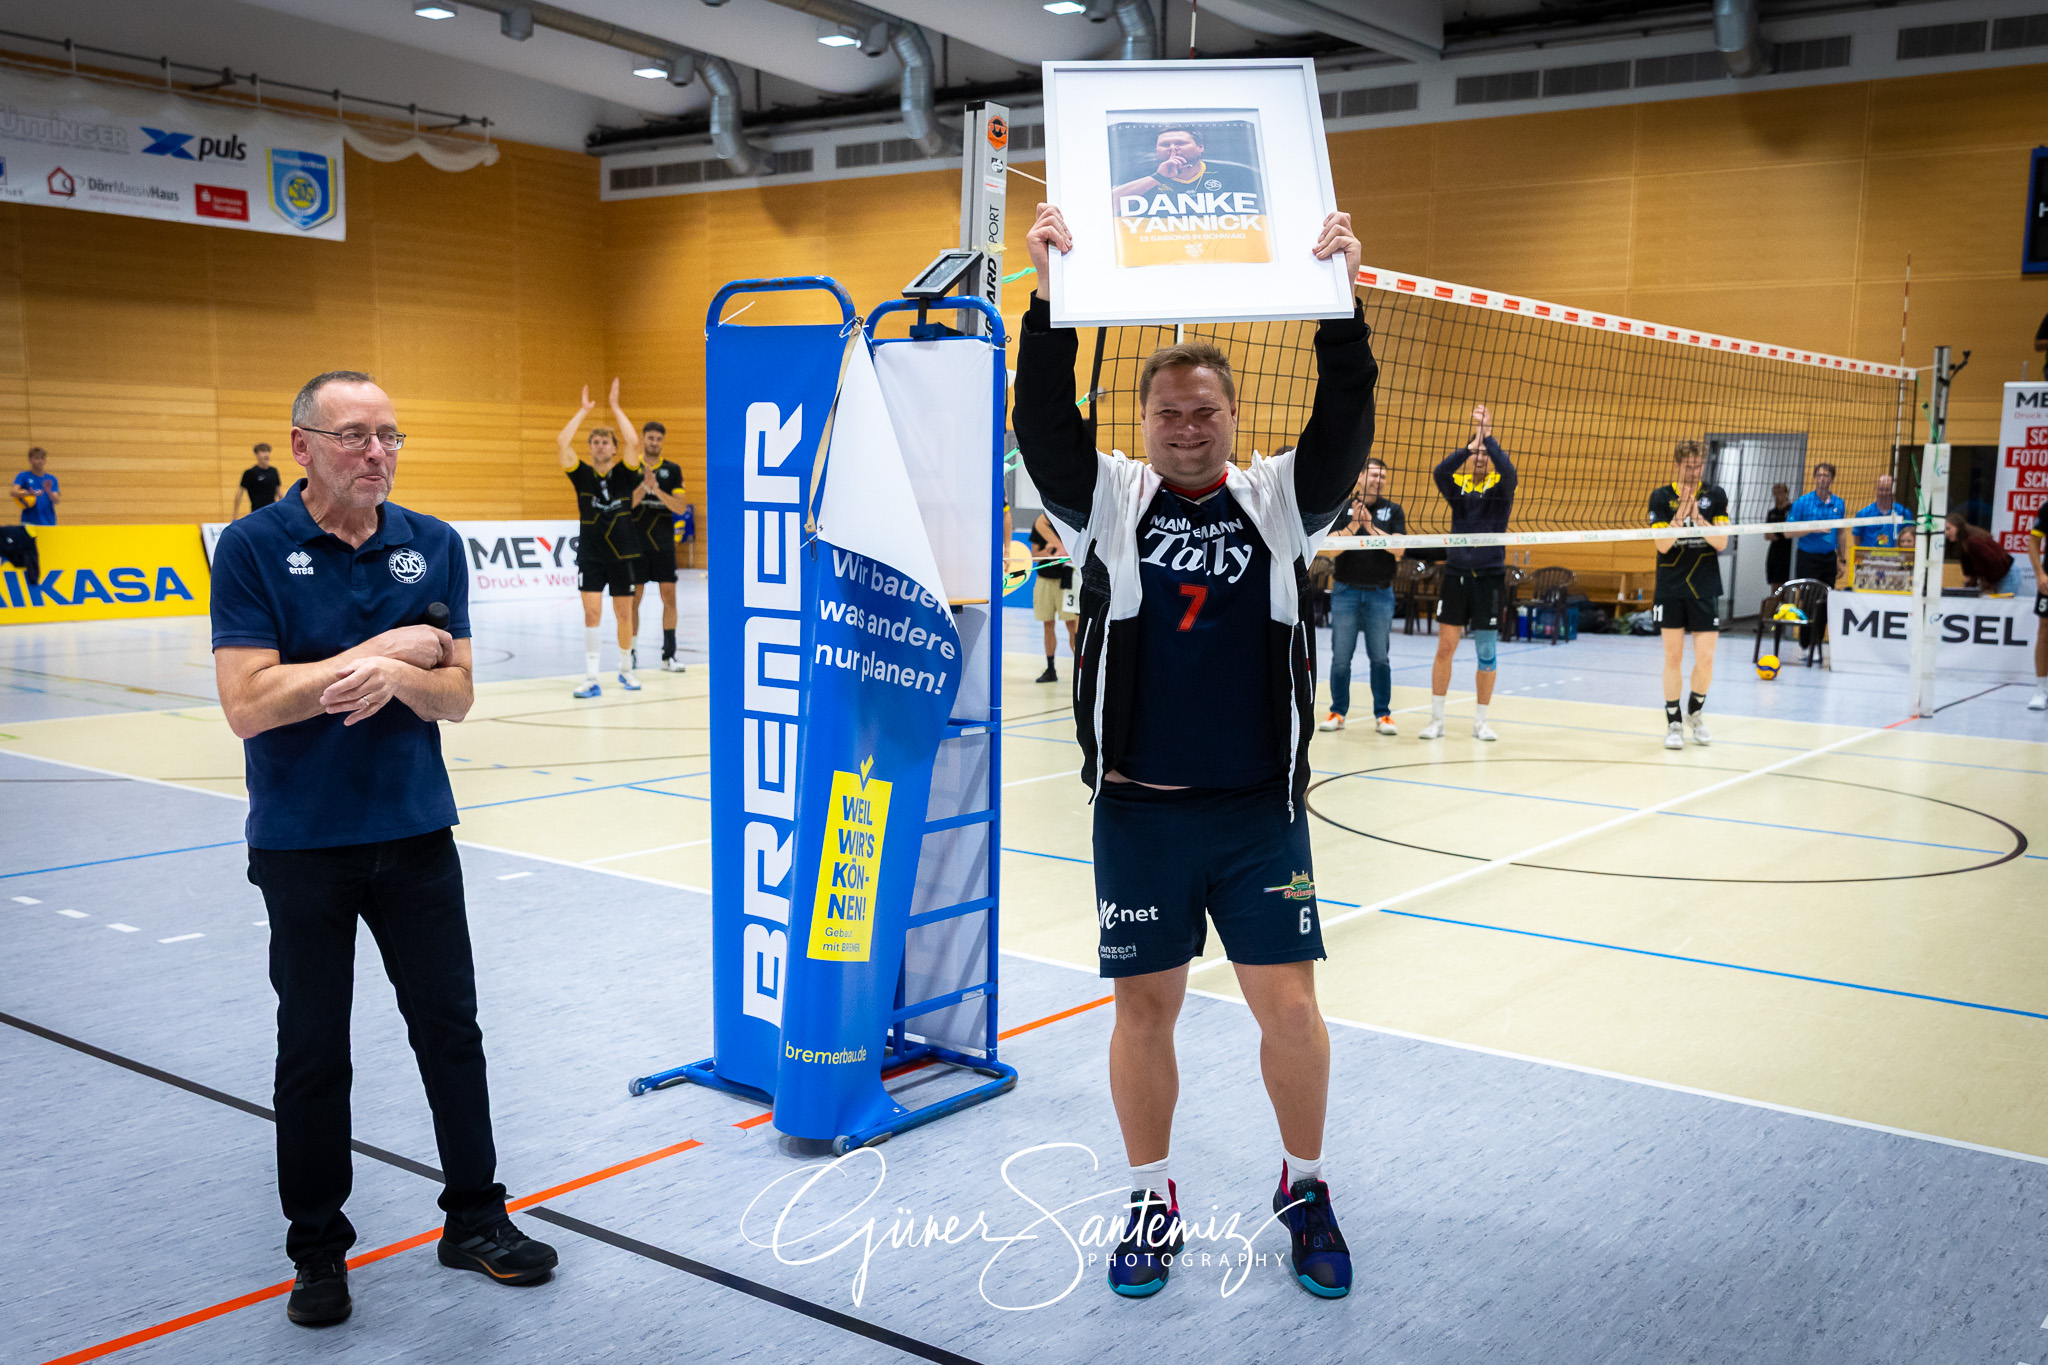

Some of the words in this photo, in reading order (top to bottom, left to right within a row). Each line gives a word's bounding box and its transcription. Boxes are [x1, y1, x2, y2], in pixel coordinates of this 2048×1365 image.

[198, 134, 247, 161] puls
[1119, 192, 1260, 217] DANKE
[1121, 214, 1263, 234] YANNICK
[477, 575, 526, 589] Druck
[832, 549, 868, 585] Wir
[0, 566, 194, 608] IKASA
[1066, 594, 1075, 607] 3
[1177, 582, 1209, 632] 7
[820, 599, 865, 629] was
[867, 617, 956, 660] andere
[1842, 608, 2029, 647] MESEL
[815, 643, 860, 671] nur
[861, 651, 947, 695] planen!
[743, 401, 802, 1028] BREMER
[842, 795, 873, 826] WEIL
[838, 828, 875, 859] WIR'S
[831, 857, 870, 890] KÖN-
[827, 893, 867, 921] NEN!
[1299, 906, 1312, 936] 6
[822, 942, 840, 952] mit
[785, 1041, 867, 1065] bremerbau.de
